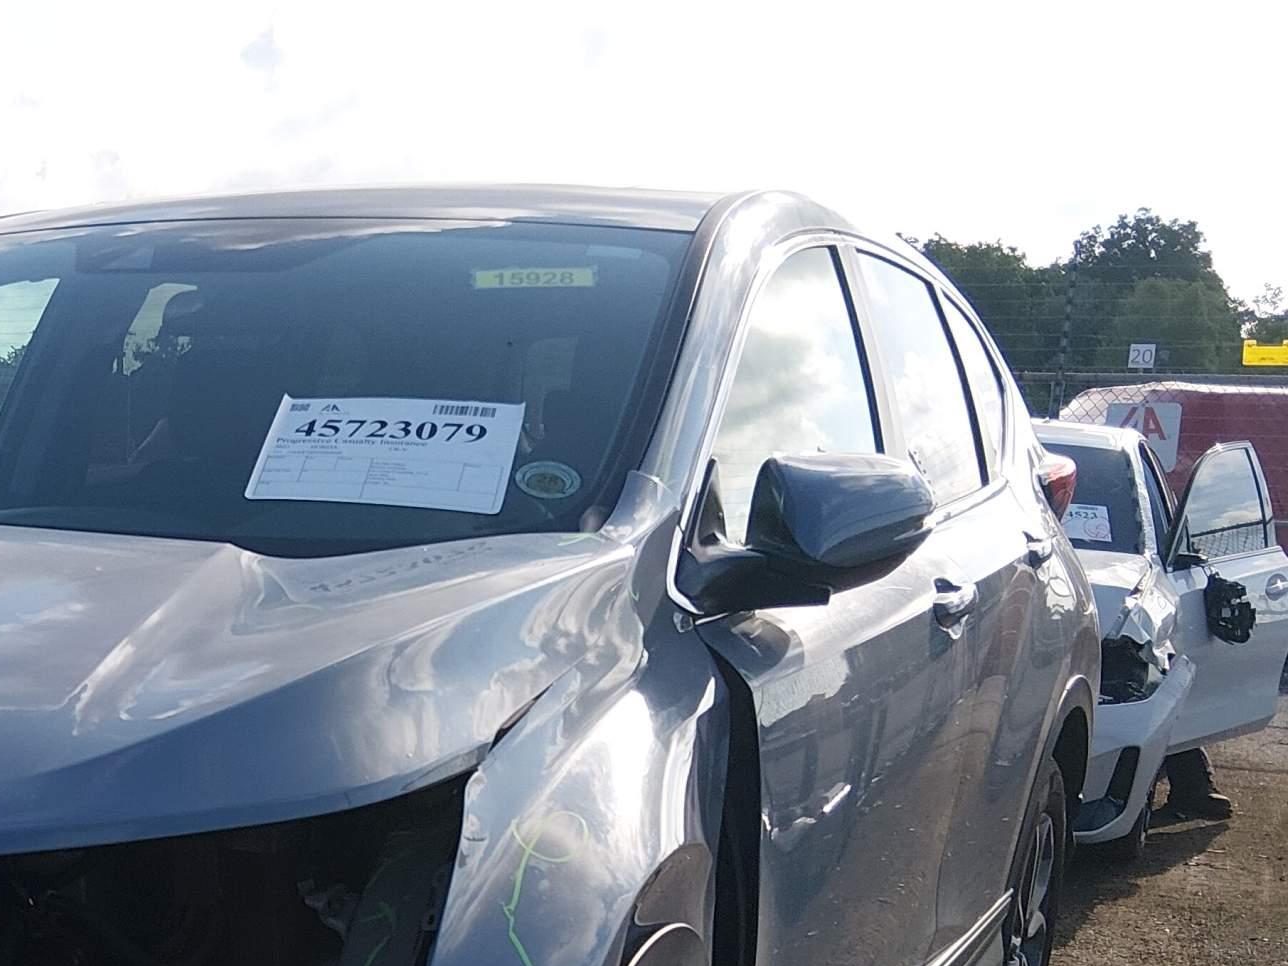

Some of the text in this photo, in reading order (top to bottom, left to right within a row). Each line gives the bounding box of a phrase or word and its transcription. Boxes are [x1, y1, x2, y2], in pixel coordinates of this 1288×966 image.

[492, 270, 574, 286] 15928
[1130, 349, 1153, 364] 20
[294, 418, 488, 443] 45723079
